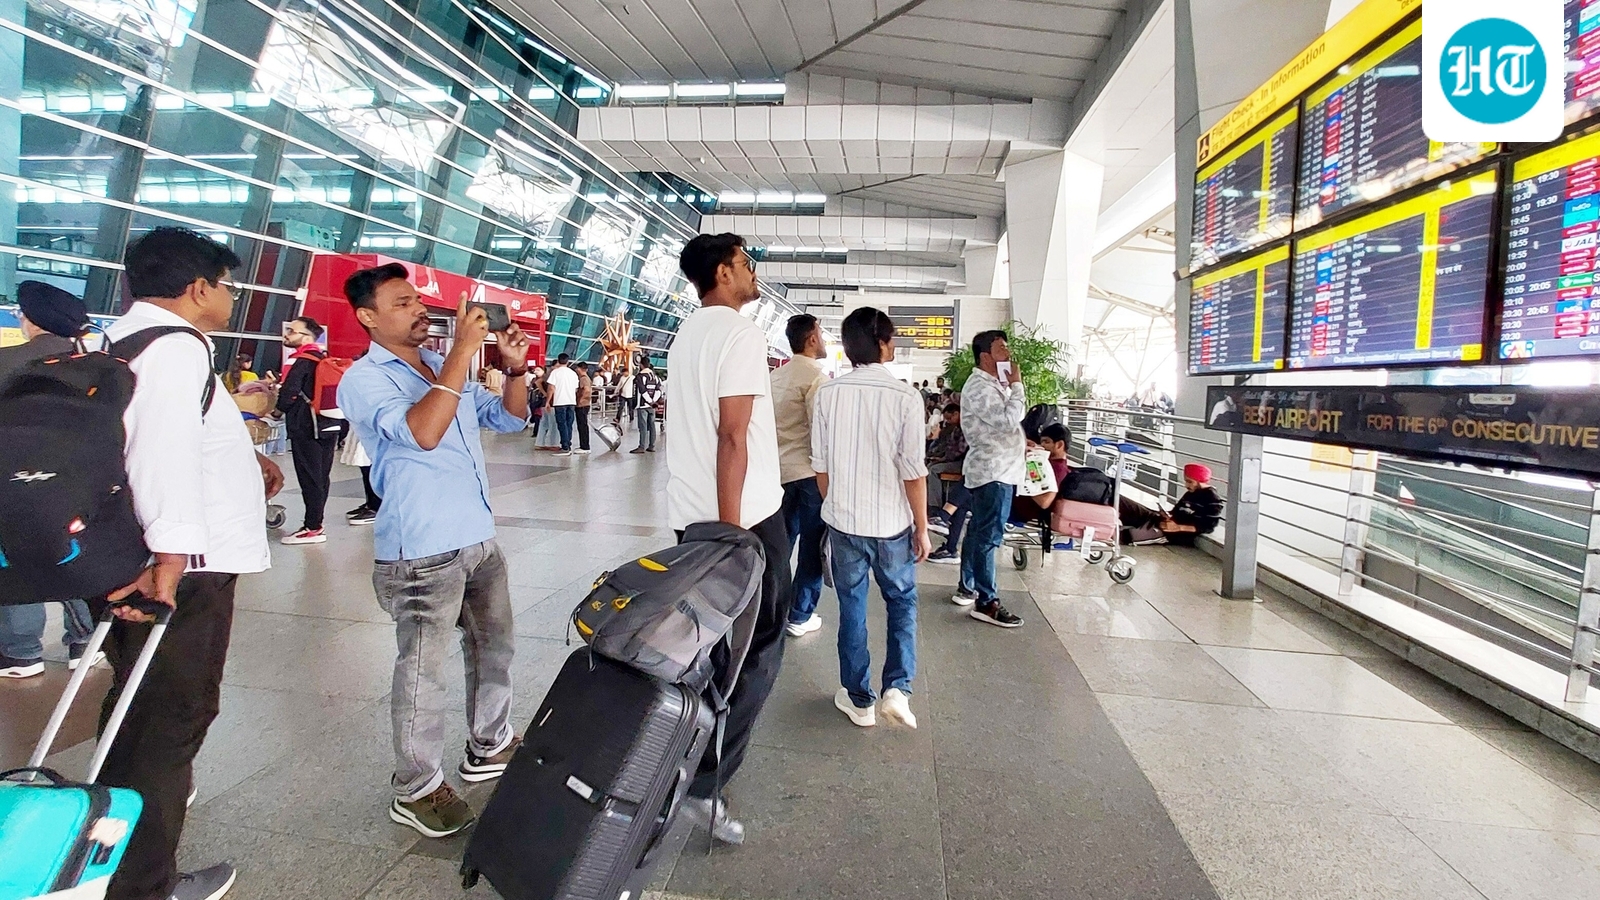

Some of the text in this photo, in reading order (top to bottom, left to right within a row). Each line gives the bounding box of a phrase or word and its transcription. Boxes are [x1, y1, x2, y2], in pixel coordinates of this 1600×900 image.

[1212, 117, 1230, 140] Flight
[1232, 99, 1254, 122] Check
[1261, 88, 1268, 101] In
[1271, 42, 1325, 92] Information
[1538, 170, 1559, 183] 19:30
[1512, 191, 1532, 203] 19:30
[1512, 195, 1558, 214] 19:30 19:30
[1510, 215, 1530, 226] 19:45
[1509, 227, 1529, 237] 19:50
[1508, 238, 1528, 249] 19:55
[1574, 237, 1593, 246] JAL
[1508, 250, 1527, 260] 19:55
[1506, 262, 1526, 272] 20:00
[1505, 274, 1526, 284] 20:00
[428, 281, 440, 294] 4A
[1504, 286, 1525, 295] 20:05
[1528, 281, 1551, 292] 20:05
[511, 300, 521, 310] 4B
[1503, 298, 1524, 307] 20:10
[1502, 309, 1523, 318] 20:30
[1526, 306, 1549, 316] 20:45
[1501, 321, 1522, 329] 20:30
[1501, 332, 1521, 341] 20:30
[1243, 405, 1600, 449] BEST AIRPORT FOR THE 6th CONSECUTIVE
